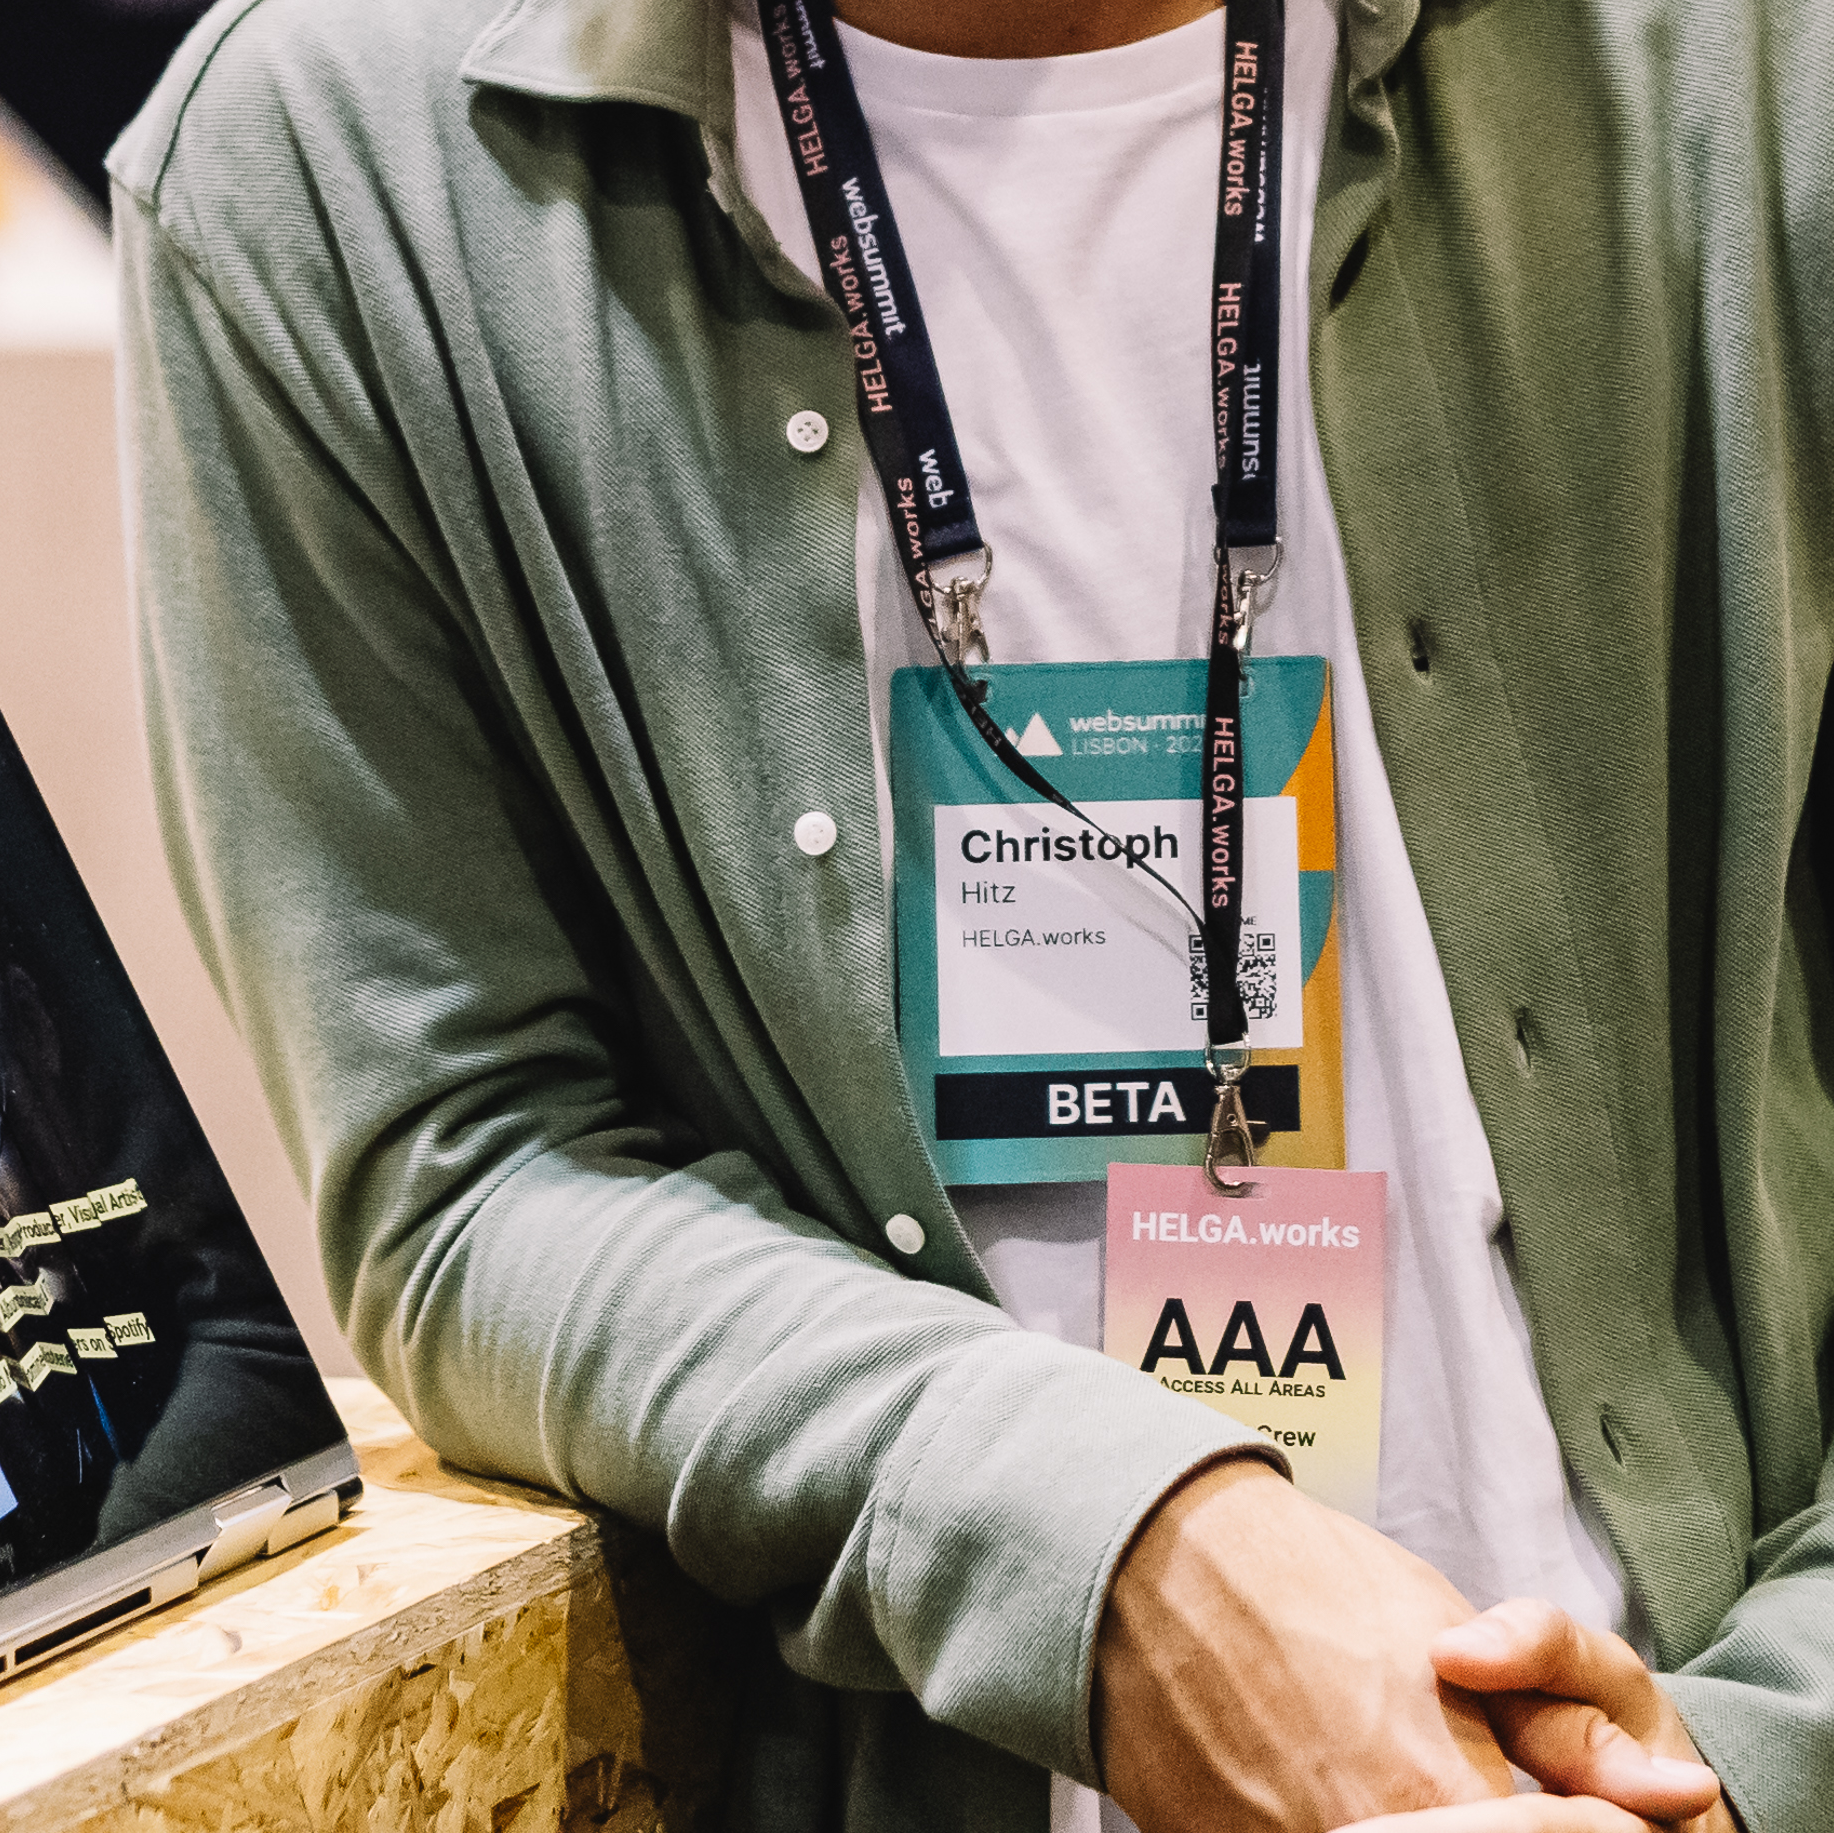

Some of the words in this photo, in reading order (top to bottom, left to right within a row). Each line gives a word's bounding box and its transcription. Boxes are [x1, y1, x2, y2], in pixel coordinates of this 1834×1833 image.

[772, 3, 829, 176] HELGA.works
[1223, 40, 1259, 217] HELGA.works
[841, 176, 907, 340] websummit
[829, 234, 893, 413] HELGA.works
[1217, 282, 1242, 470] HELGA.works
[918, 448, 955, 509] web
[1071, 736, 1148, 755] LISBON
[1165, 734, 1205, 754] 202
[960, 825, 1179, 869] Christoph
[1210, 716, 1237, 909] HELGA.works
[961, 881, 1017, 904] Hitz
[962, 927, 1107, 949] HELGA.works
[1048, 1081, 1187, 1125] BETA
[1132, 1211, 1361, 1249] HELGA.works
[1139, 1297, 1348, 1381] AAA
